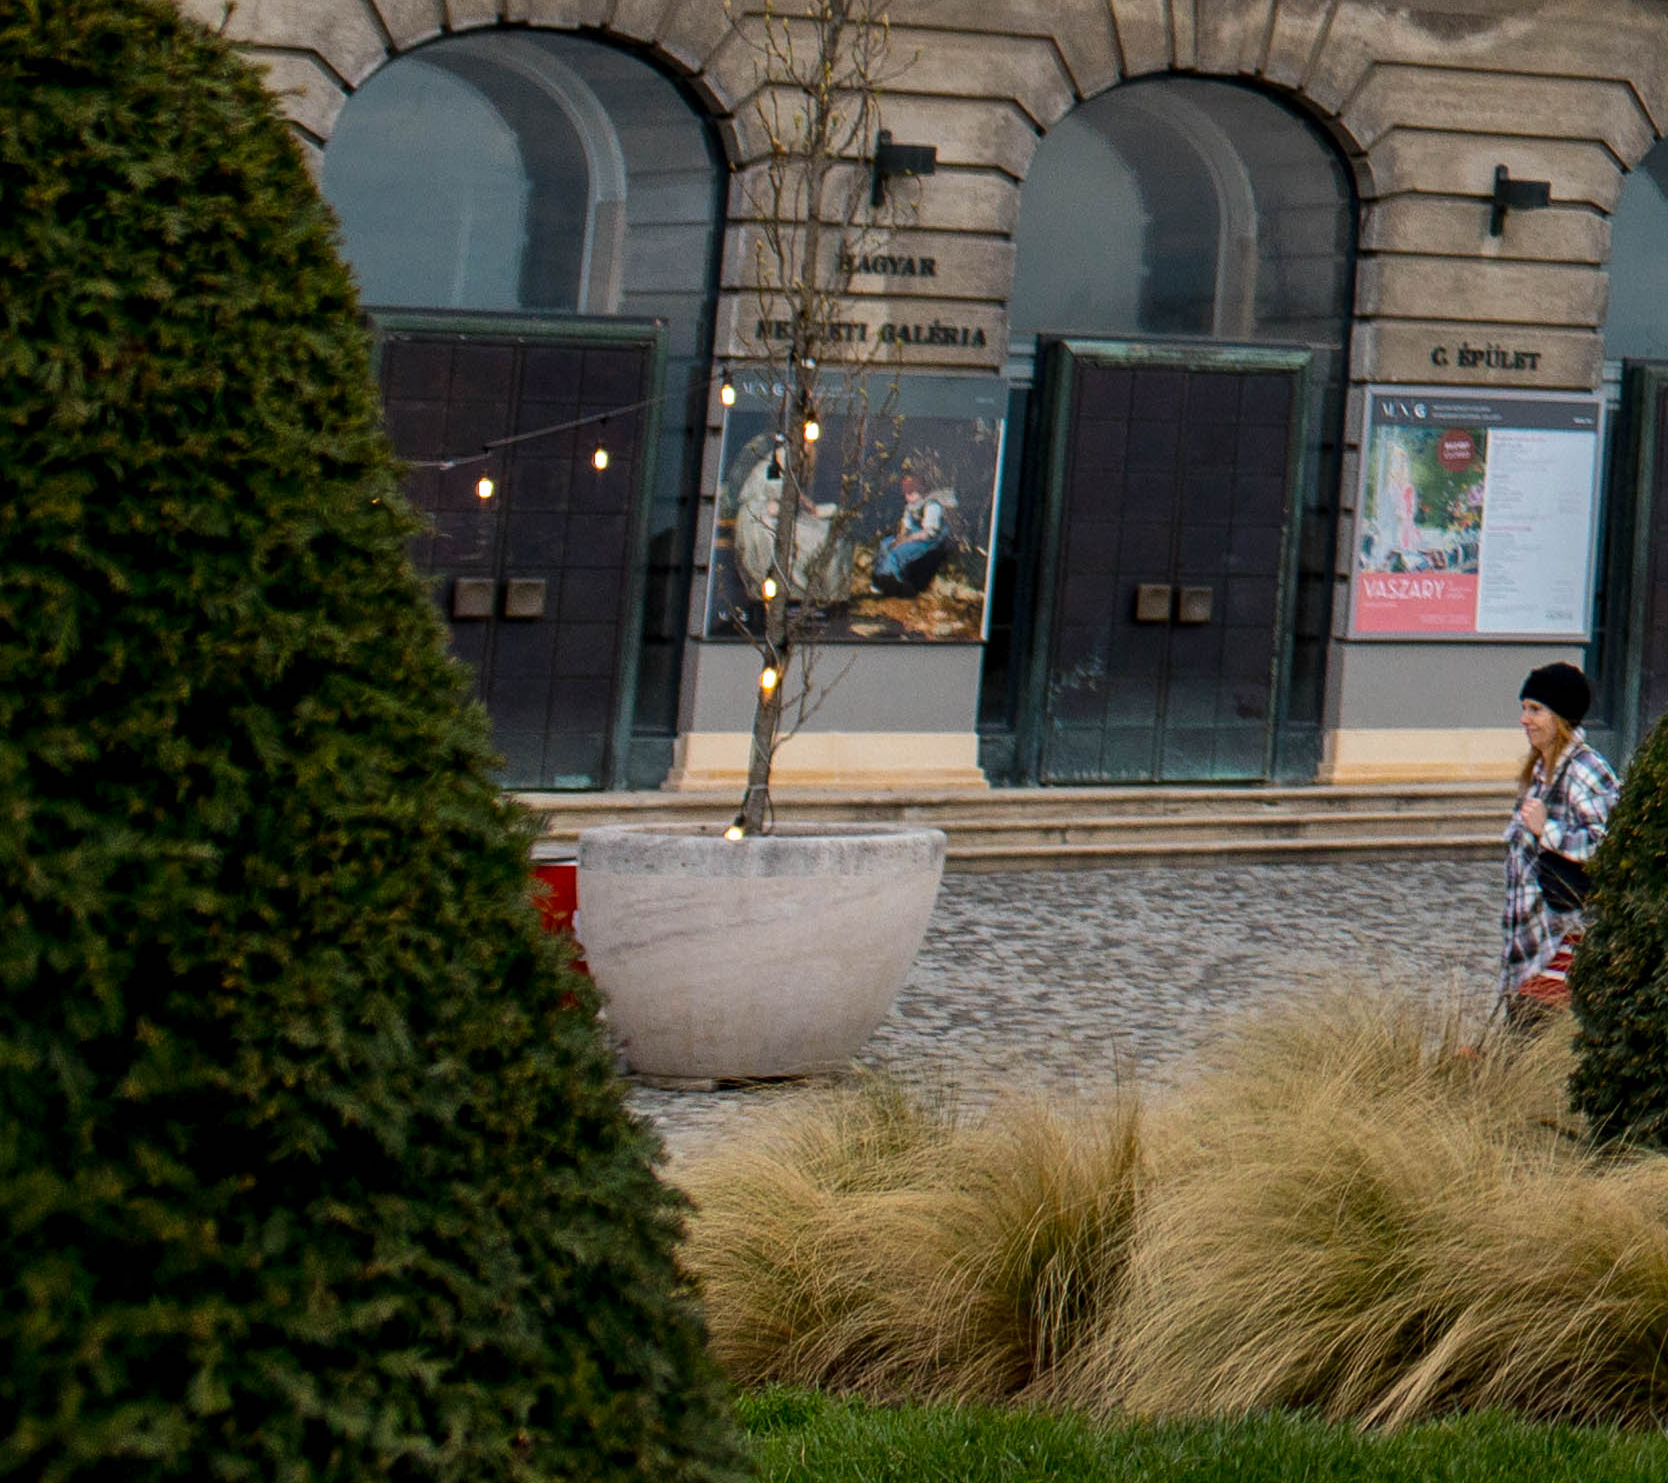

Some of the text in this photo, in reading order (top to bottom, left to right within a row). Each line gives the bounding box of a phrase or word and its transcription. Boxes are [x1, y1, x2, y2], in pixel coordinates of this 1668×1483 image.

[755, 318, 987, 347] NEETI GALÉRIA
[1457, 341, 1542, 371] ÉPÜLET
[1363, 577, 1445, 600] VASZARY
